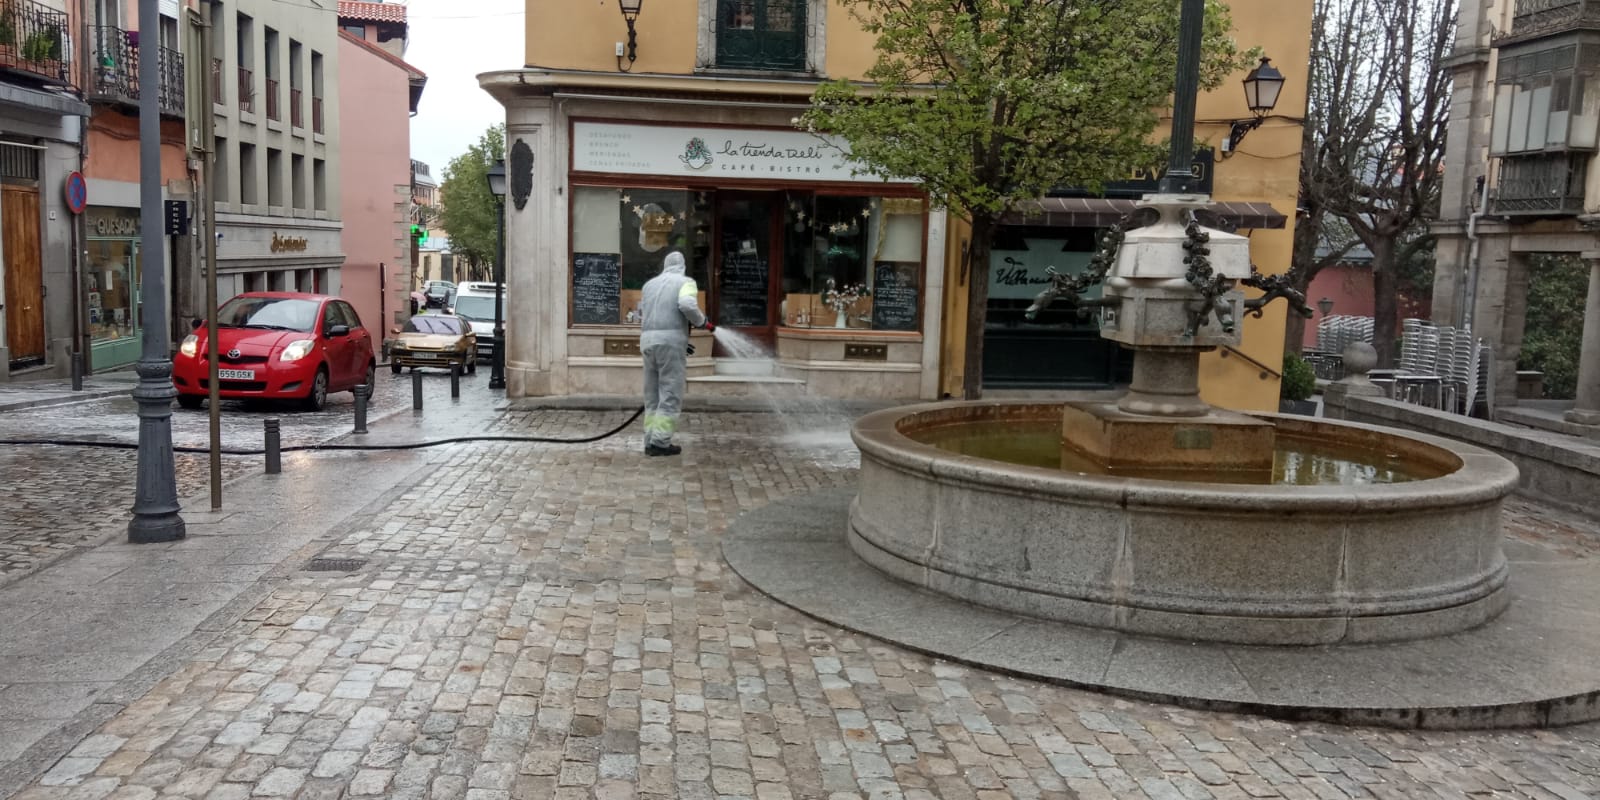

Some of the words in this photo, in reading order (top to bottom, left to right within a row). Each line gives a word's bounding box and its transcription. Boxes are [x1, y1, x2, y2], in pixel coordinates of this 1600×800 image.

[716, 140, 738, 156] la
[740, 142, 784, 159] tienda
[721, 163, 755, 171] CAFÉ
[97, 218, 137, 235] QUESADA
[172, 201, 180, 235] PRENSA
